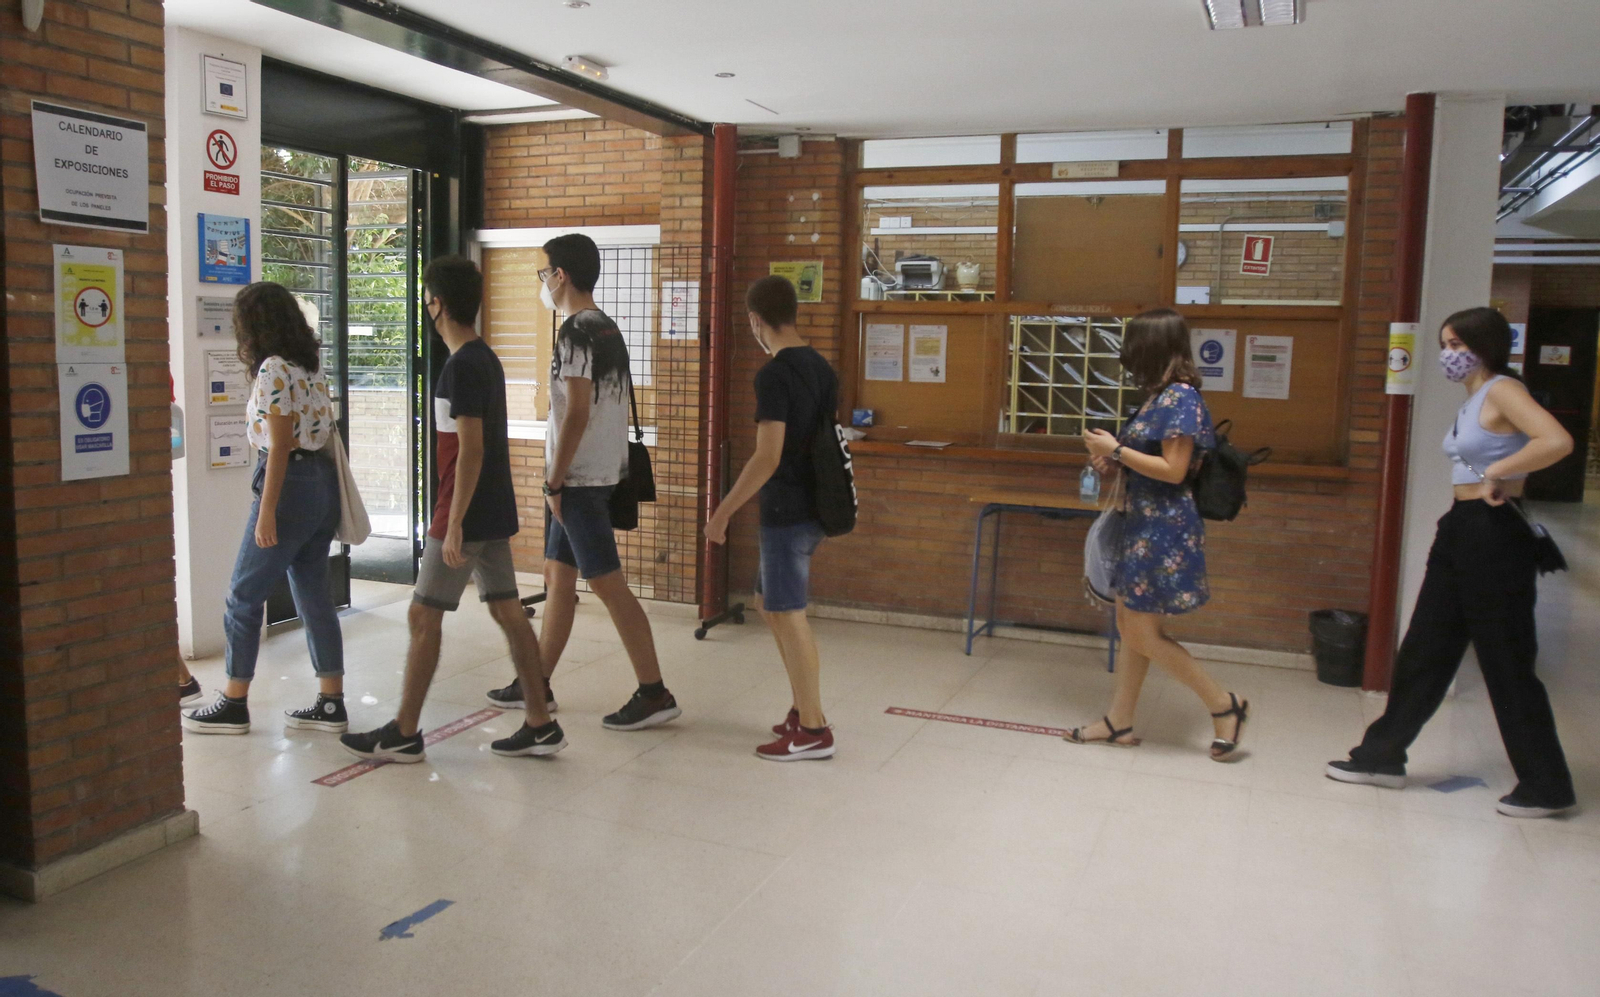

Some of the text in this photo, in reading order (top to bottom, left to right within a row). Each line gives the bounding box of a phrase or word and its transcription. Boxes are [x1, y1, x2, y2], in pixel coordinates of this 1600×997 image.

[58, 120, 123, 142] CALENDARIO
[84, 144, 99, 156] DE
[54, 158, 129, 179] EXPOSICIONES
[205, 172, 239, 184] PROHIBIDO
[210, 180, 236, 190] EL PASO
[65, 188, 93, 198] OCUPACIÓN
[91, 203, 111, 211] PANELES
[905, 710, 967, 723] MANTENGA
[969, 718, 984, 726] LA
[985, 720, 1046, 734] DISTANCIA
